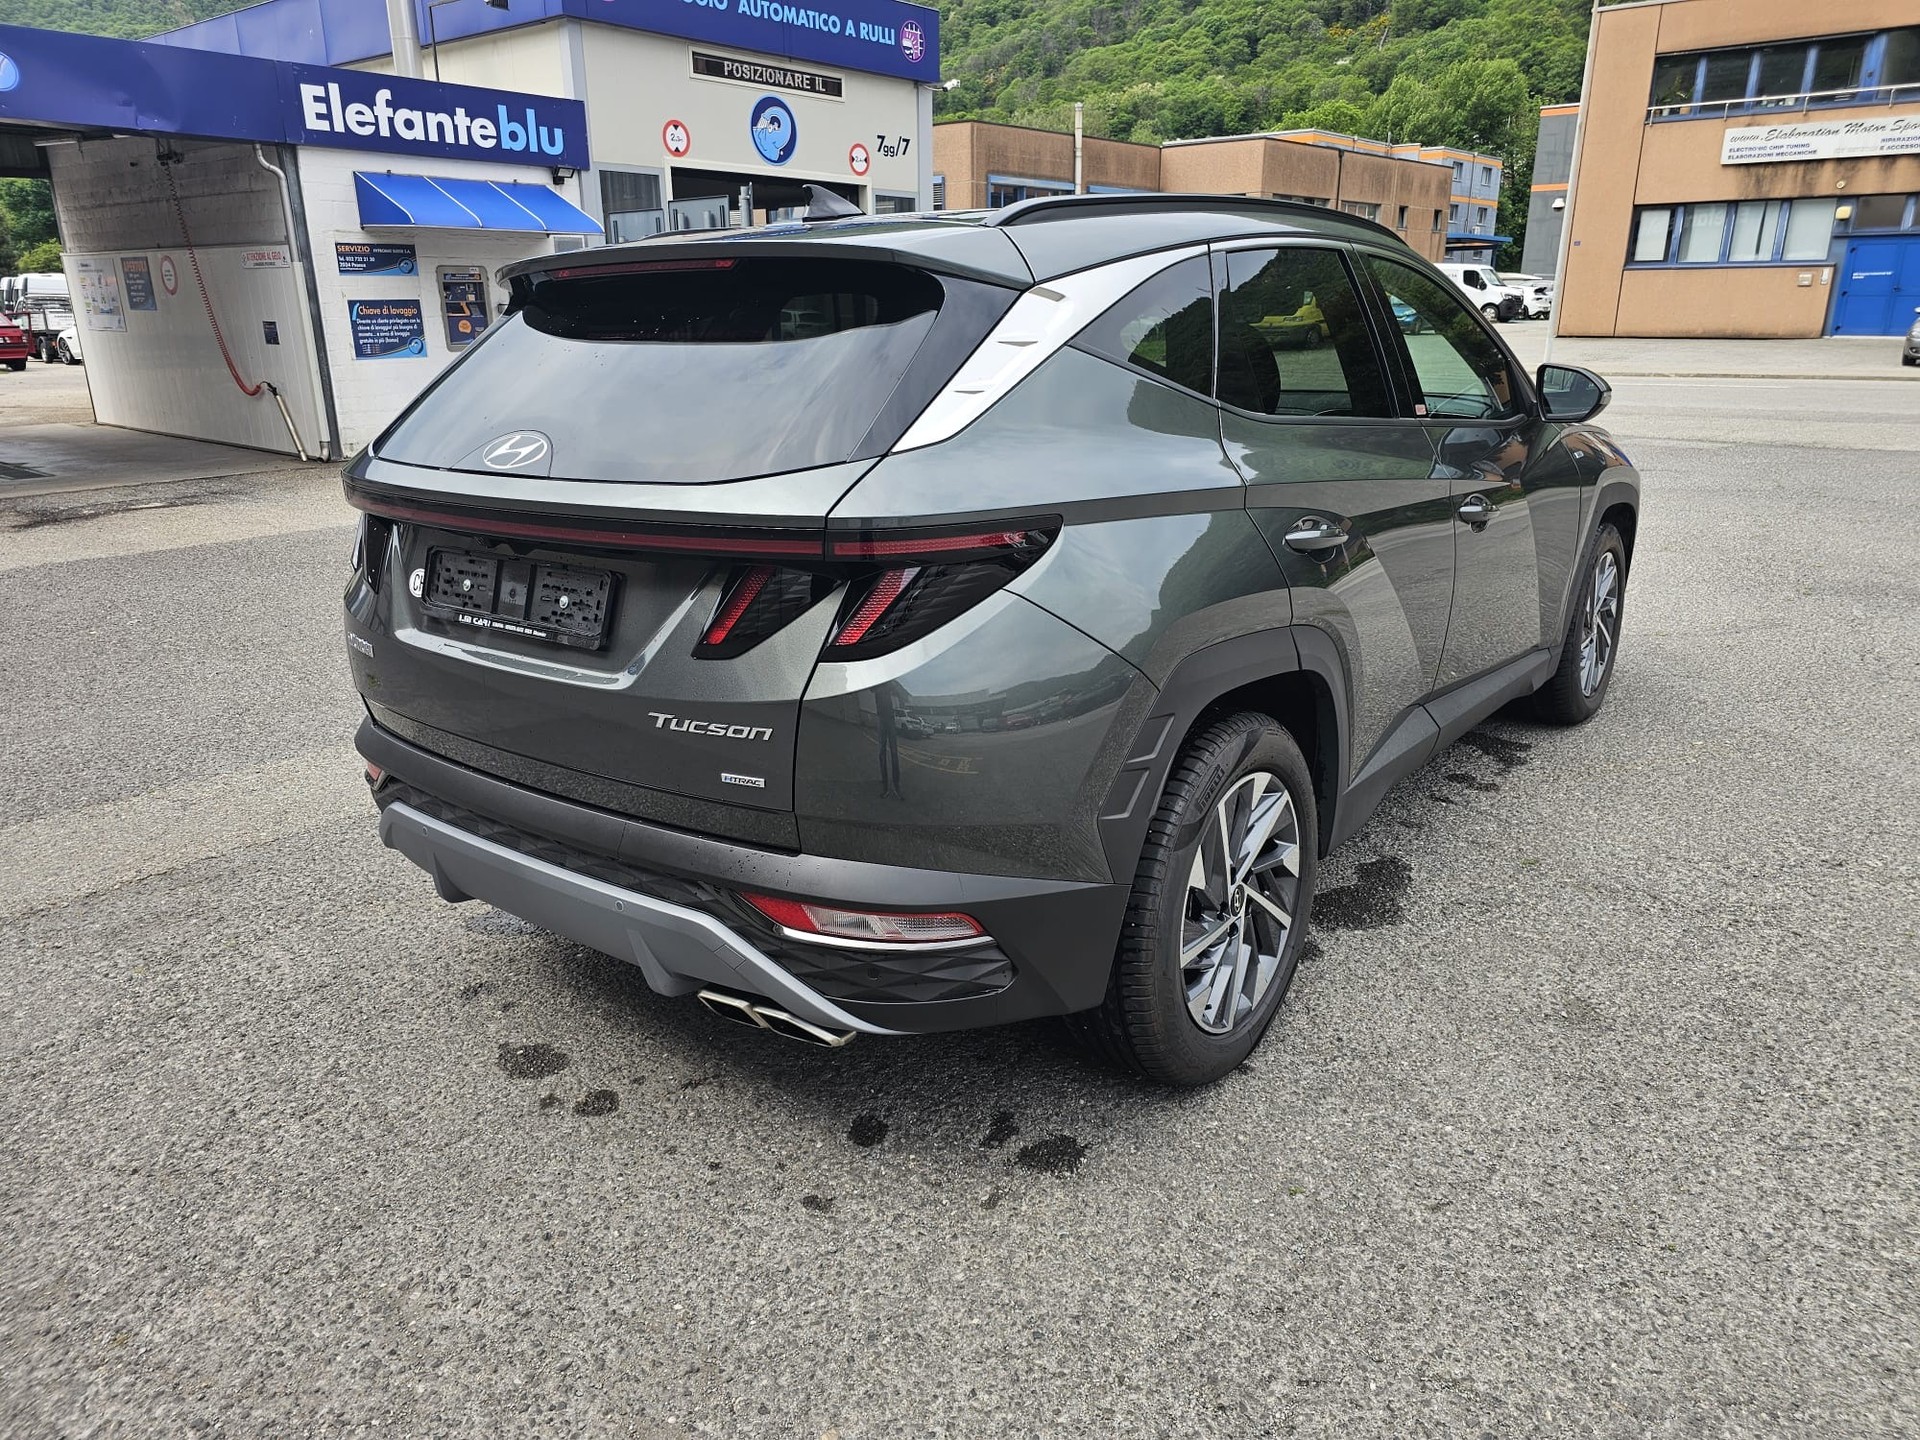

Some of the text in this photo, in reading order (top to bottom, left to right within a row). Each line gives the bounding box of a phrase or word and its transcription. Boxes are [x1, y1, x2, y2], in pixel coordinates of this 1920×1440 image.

[738, 0, 840, 34] AUTOMATICO
[845, 19, 856, 37] A
[860, 22, 895, 45] RULLI
[724, 61, 826, 92] POSIZIONARE IL
[1844, 122, 1887, 134] Motor
[877, 134, 911, 157] 7gg/7
[358, 305, 417, 316] Chiave di lavaggio
[724, 775, 762, 786] HTRAC
